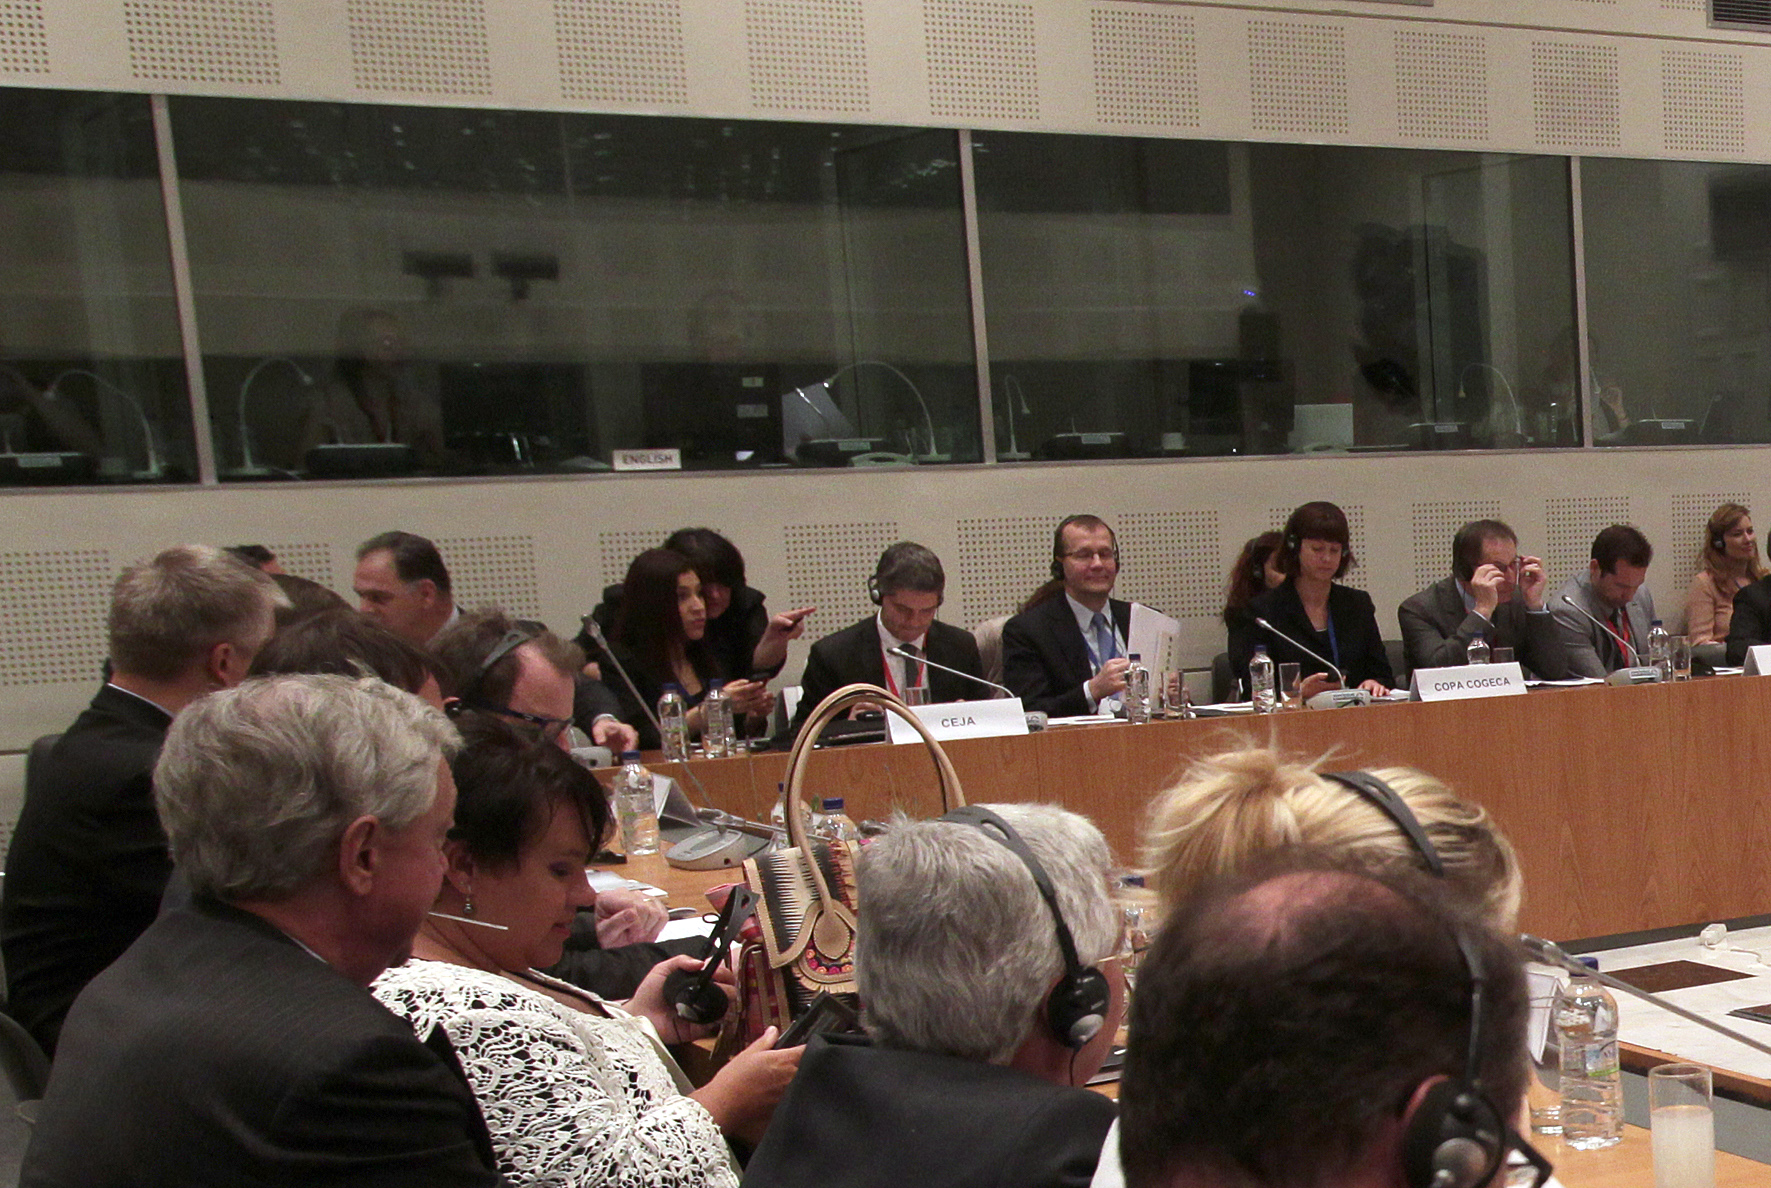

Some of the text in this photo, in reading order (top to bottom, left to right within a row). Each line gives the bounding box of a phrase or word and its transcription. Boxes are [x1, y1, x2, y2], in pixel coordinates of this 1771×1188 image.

[621, 453, 675, 464] ENGLISH
[1434, 677, 1511, 692] COPA COGECA
[941, 716, 976, 728] CEJA
